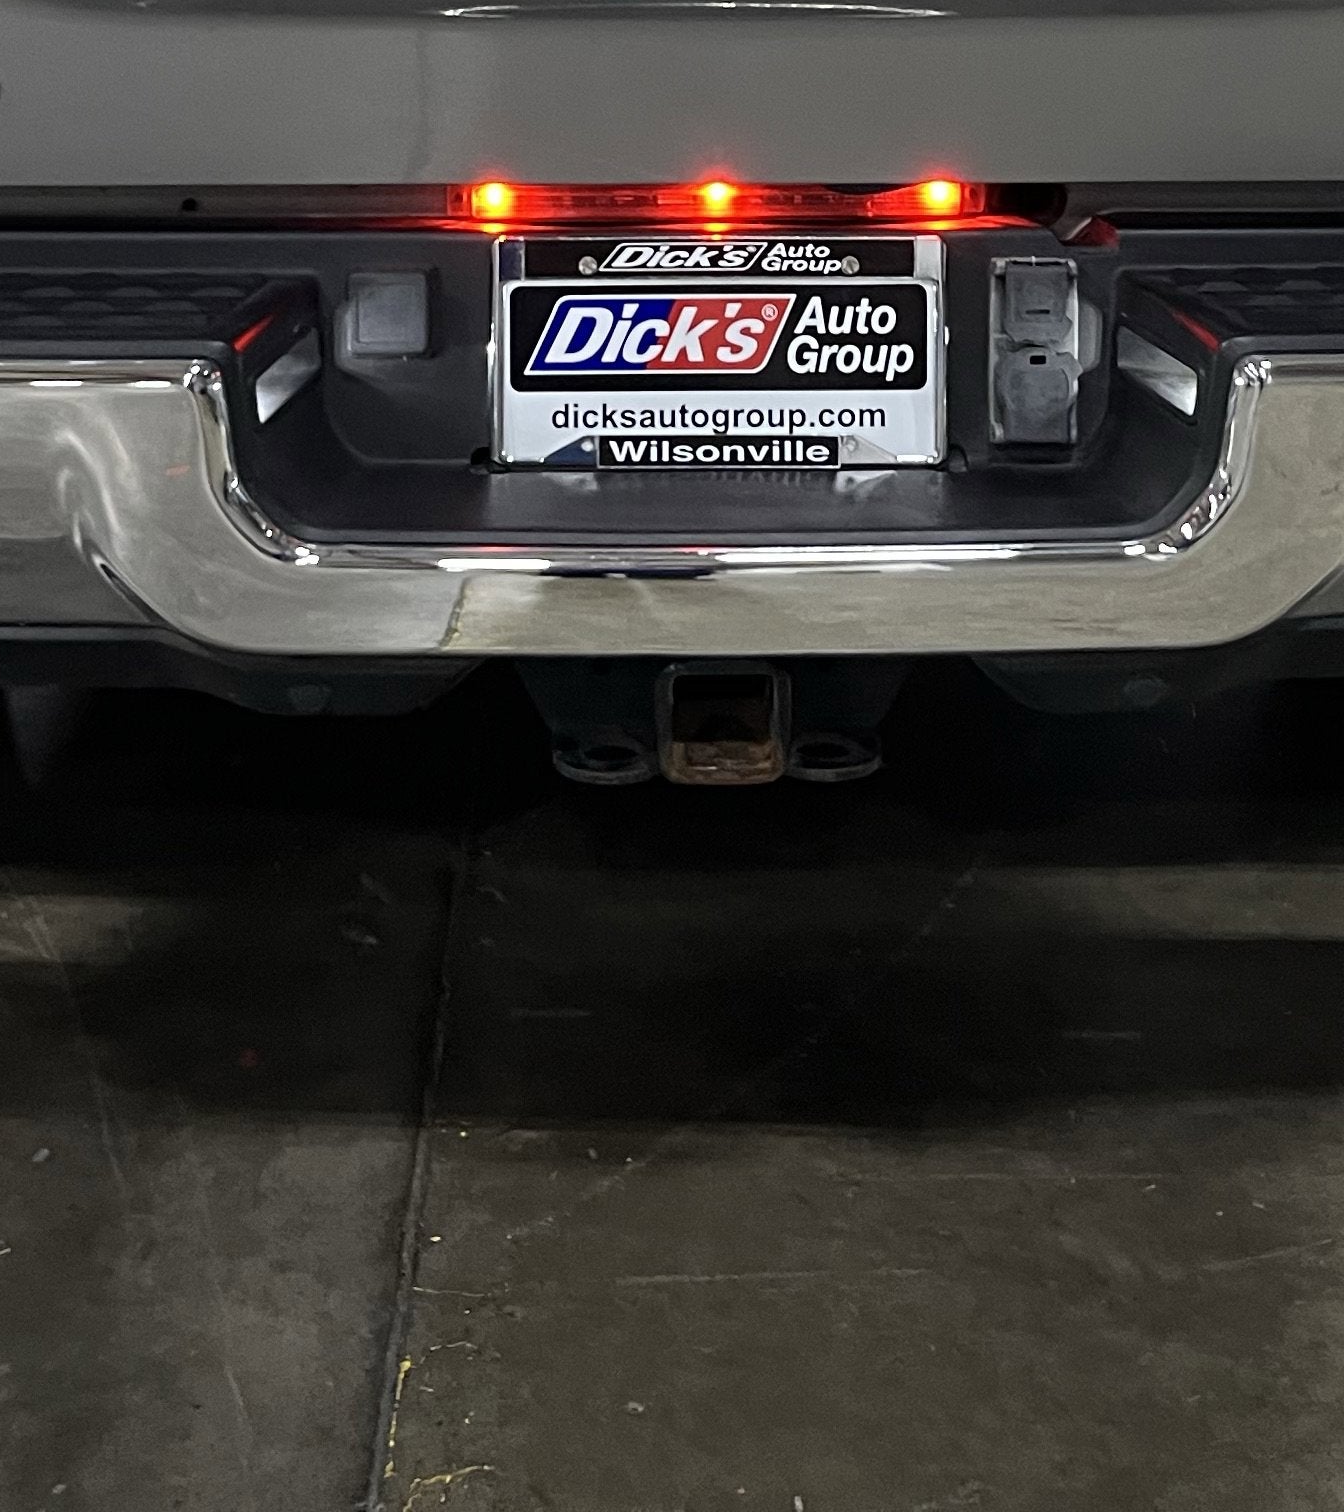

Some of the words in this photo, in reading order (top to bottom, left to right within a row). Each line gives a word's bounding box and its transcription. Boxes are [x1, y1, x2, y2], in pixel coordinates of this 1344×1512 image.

[767, 243, 831, 258] Auto
[761, 257, 842, 274] Group
[795, 296, 897, 335] Auto
[787, 336, 914, 382] Group
[551, 403, 886, 434] dicksautogroup.com
[608, 441, 830, 464] Wilsonville
